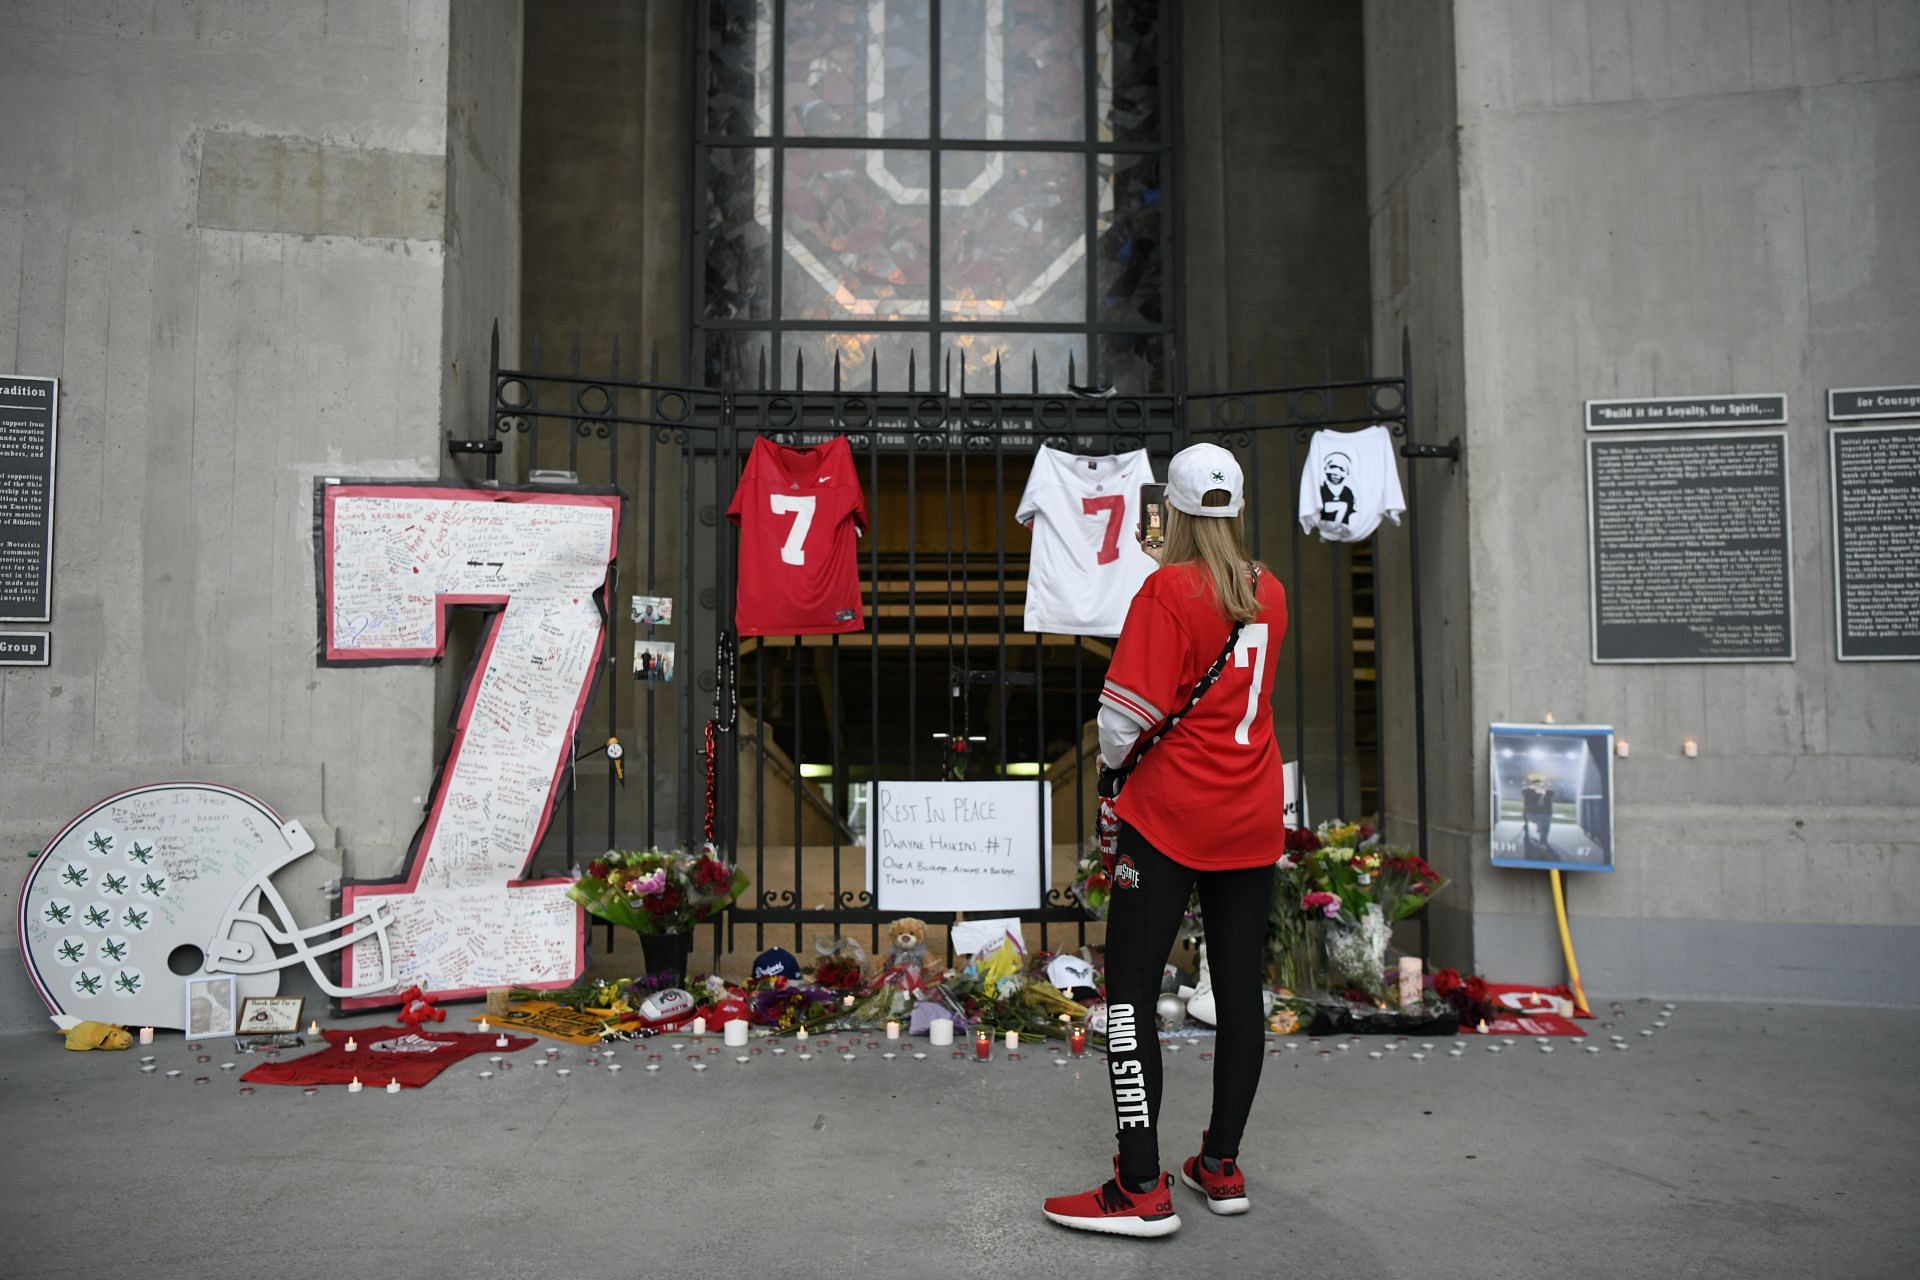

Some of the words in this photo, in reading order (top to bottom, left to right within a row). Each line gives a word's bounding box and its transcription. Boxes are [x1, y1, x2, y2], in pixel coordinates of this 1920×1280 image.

[1635, 407, 1645, 417] it
[1648, 407, 1664, 417] for
[1666, 405, 1708, 418] Loyalty,
[1710, 405, 1725, 415] for
[1857, 397, 1873, 407] for
[1325, 502, 1347, 524] 7
[770, 494, 816, 565] 7
[1082, 495, 1124, 565] 7
[0, 642, 37, 654] Group
[1234, 624, 1268, 745] 7
[925, 796, 946, 823] IN
[954, 797, 997, 822] PEACE
[756, 961, 785, 978] Dodgers
[1108, 1003, 1138, 1053] OHIO
[1112, 1059, 1150, 1130] STATE
